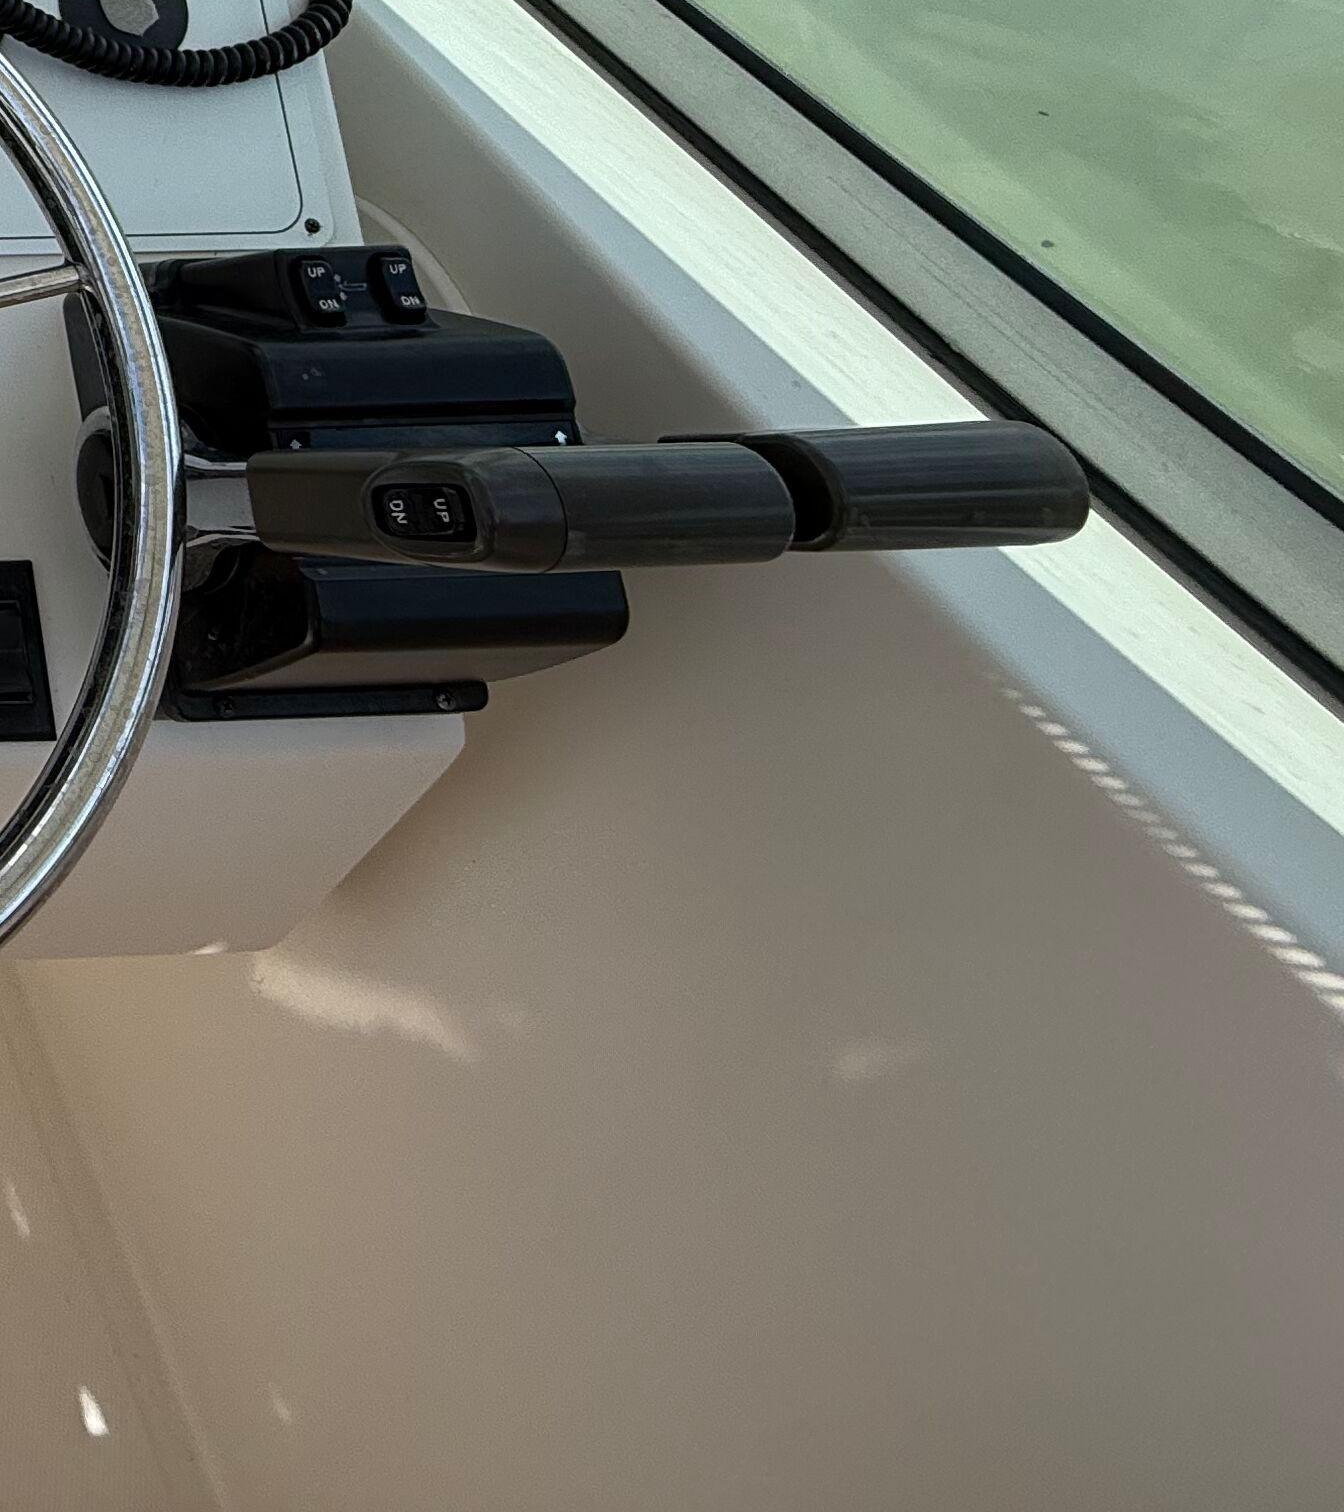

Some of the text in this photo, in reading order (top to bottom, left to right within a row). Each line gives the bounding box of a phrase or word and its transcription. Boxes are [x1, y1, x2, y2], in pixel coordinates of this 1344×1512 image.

[307, 266, 326, 278] UP
[389, 263, 407, 275] UP
[433, 498, 450, 523] UP
